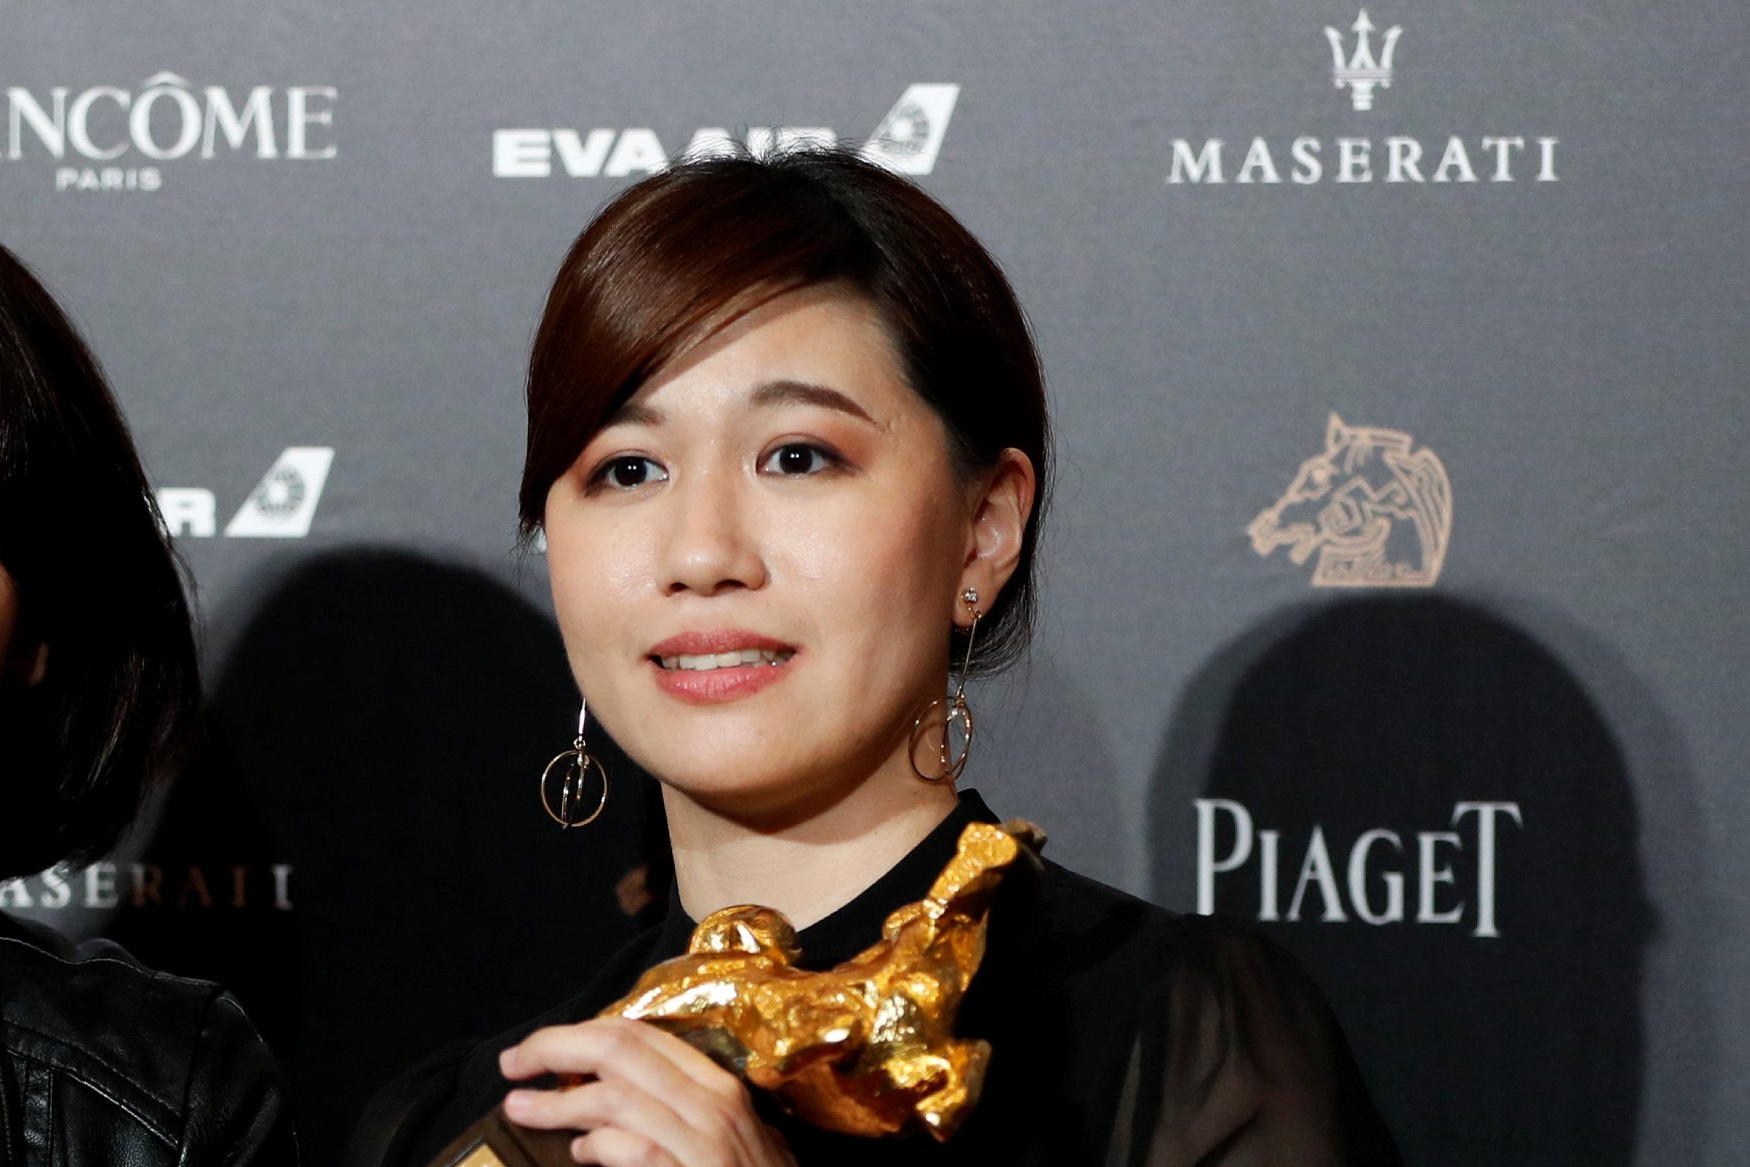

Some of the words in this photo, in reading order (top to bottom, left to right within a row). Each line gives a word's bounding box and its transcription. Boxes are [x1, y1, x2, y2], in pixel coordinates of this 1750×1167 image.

[55, 166, 162, 192] PARIS
[1166, 135, 1560, 185] MASERATI
[1192, 797, 1524, 938] PIAGET
